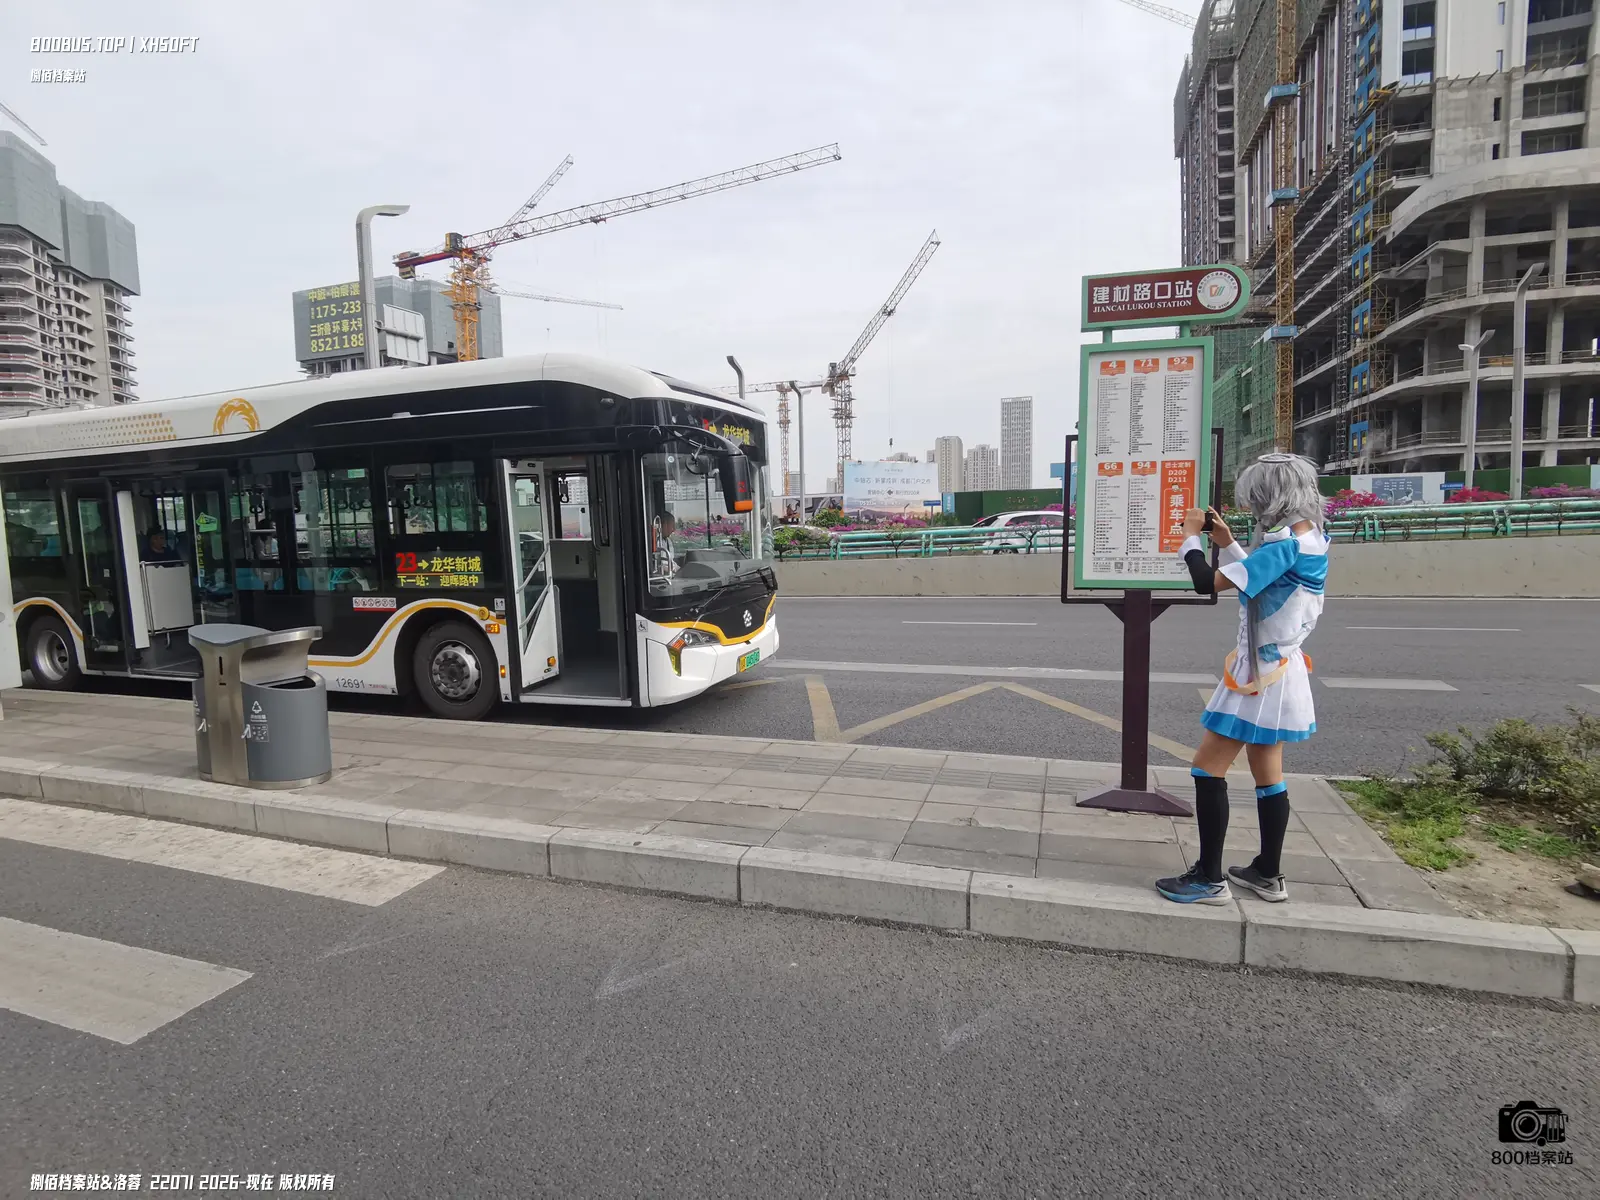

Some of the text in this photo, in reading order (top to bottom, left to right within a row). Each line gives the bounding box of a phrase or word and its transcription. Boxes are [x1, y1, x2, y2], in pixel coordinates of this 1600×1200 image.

[1092, 280, 1193, 304] 建材路口站
[1093, 300, 1192, 313] JIANCAI LUKOU STATION
[1108, 361, 1118, 369] 4
[1140, 359, 1154, 367] 71
[1173, 357, 1188, 365] 92
[1104, 462, 1118, 470] 66
[1137, 461, 1151, 469] 94
[1169, 494, 1184, 535] 乘车点
[396, 552, 481, 572] 23 龙华新城
[440, 574, 479, 587] 迎晖路中
[335, 677, 365, 689] 12691
